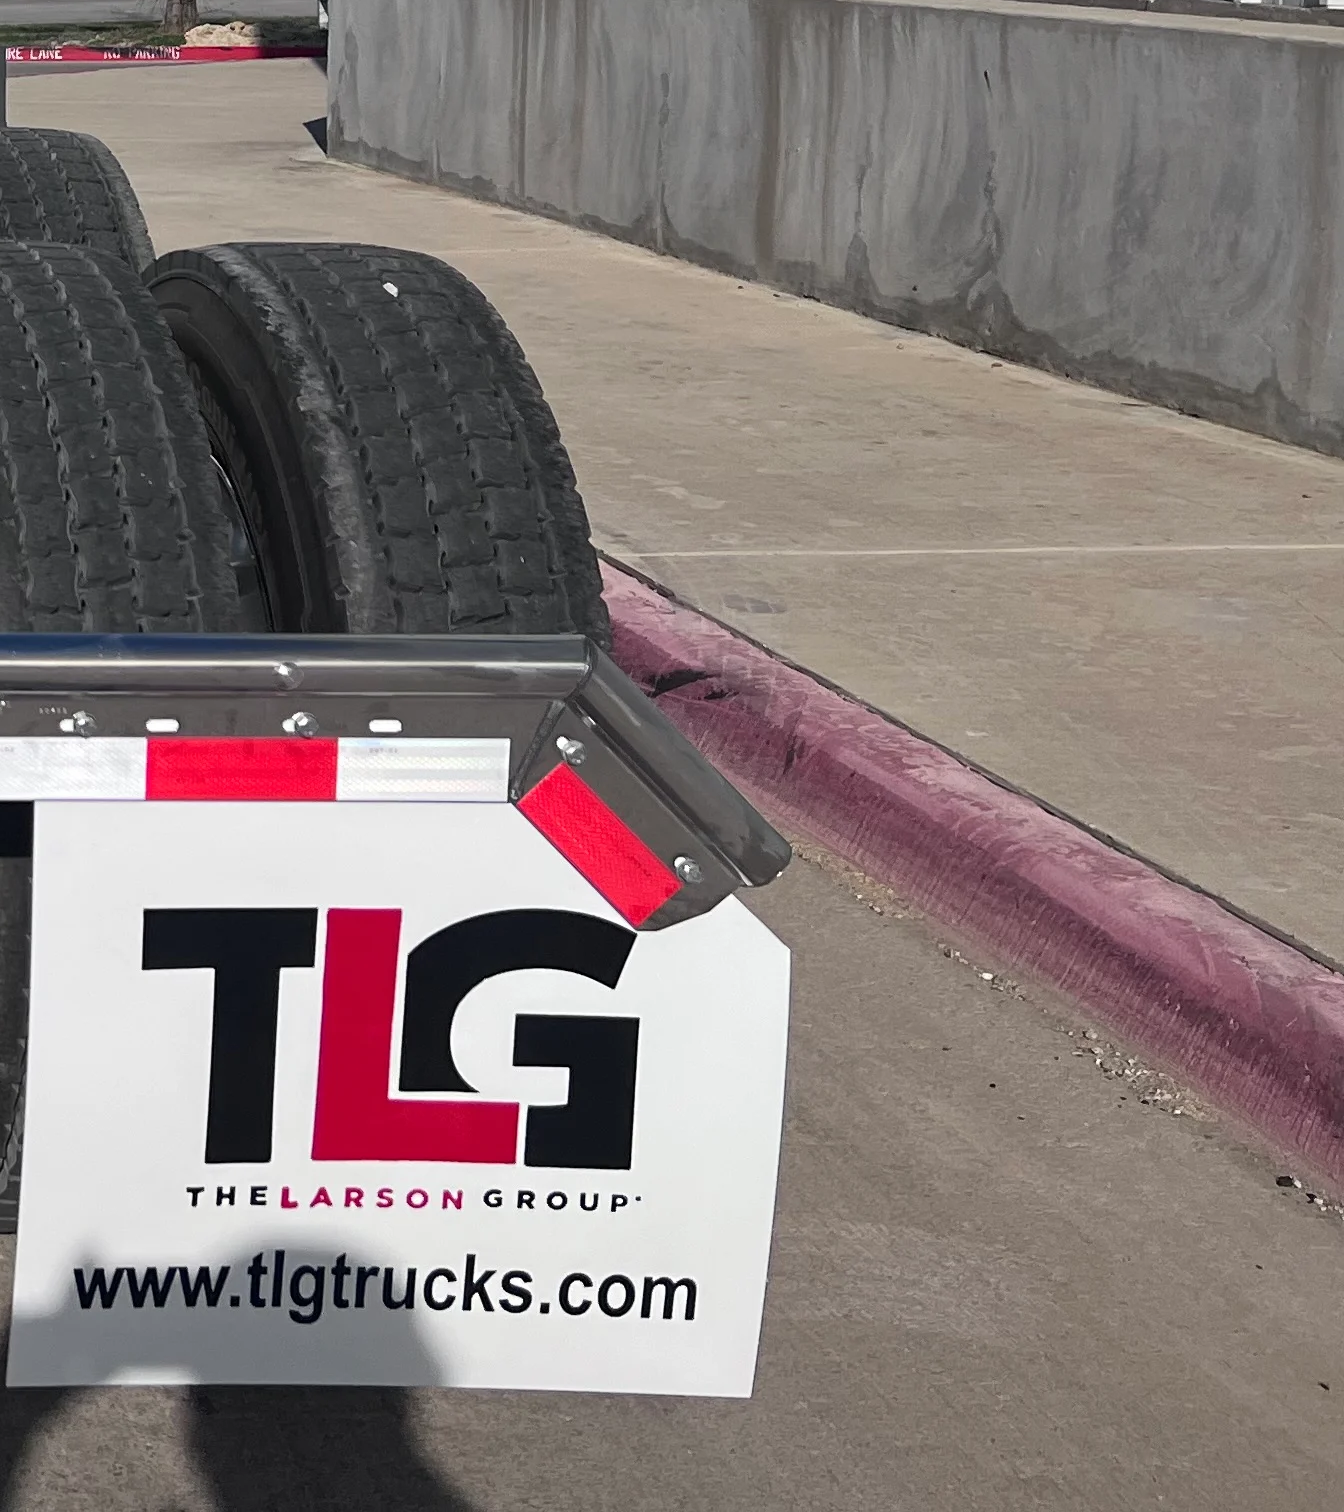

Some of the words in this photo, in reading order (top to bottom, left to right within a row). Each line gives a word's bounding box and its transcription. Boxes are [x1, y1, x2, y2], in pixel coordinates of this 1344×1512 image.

[5, 46, 24, 60] IRE
[30, 46, 63, 60] LANE
[142, 908, 641, 1171] TLG
[483, 1189, 628, 1213] GROUP
[73, 1249, 697, 1325] www.tlgtrucks.com
